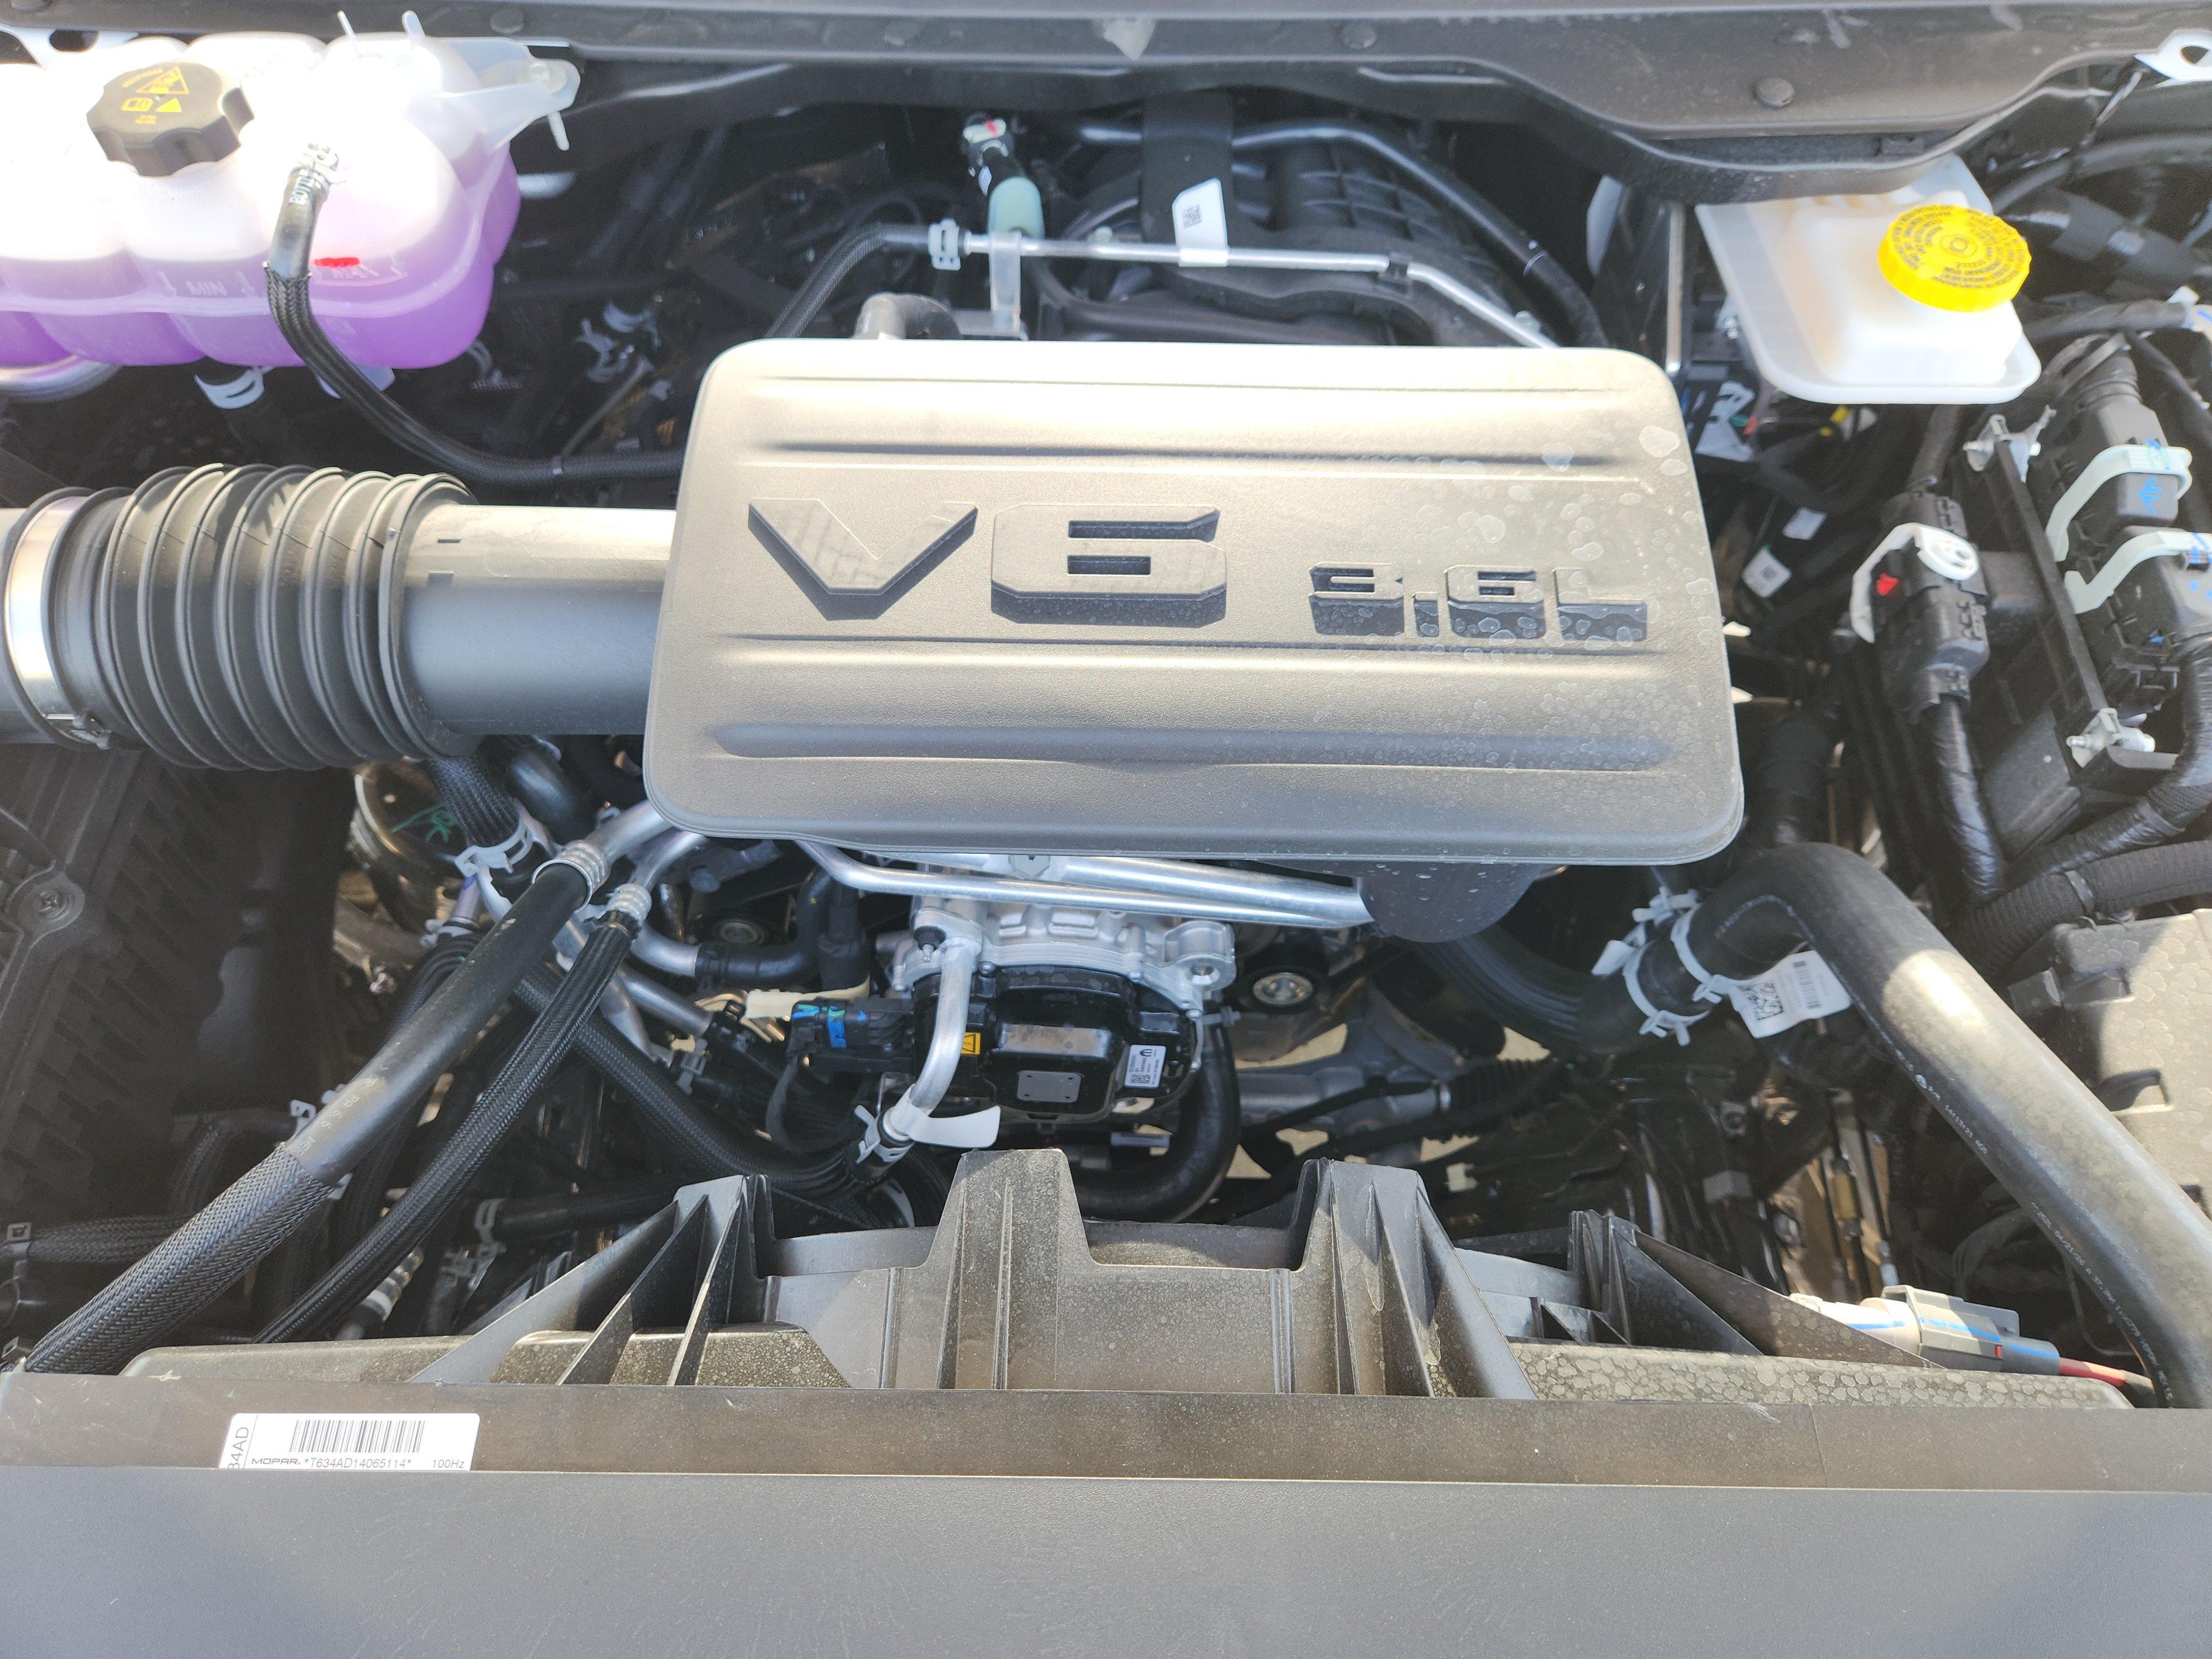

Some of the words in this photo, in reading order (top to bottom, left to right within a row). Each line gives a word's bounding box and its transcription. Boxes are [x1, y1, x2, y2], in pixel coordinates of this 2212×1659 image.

[186, 281, 227, 296] MIN
[747, 498, 1228, 615] V6
[1308, 562, 1648, 624] 3.6L
[343, 1093, 360, 1108] PA
[432, 1458, 465, 1469] 100Hz
